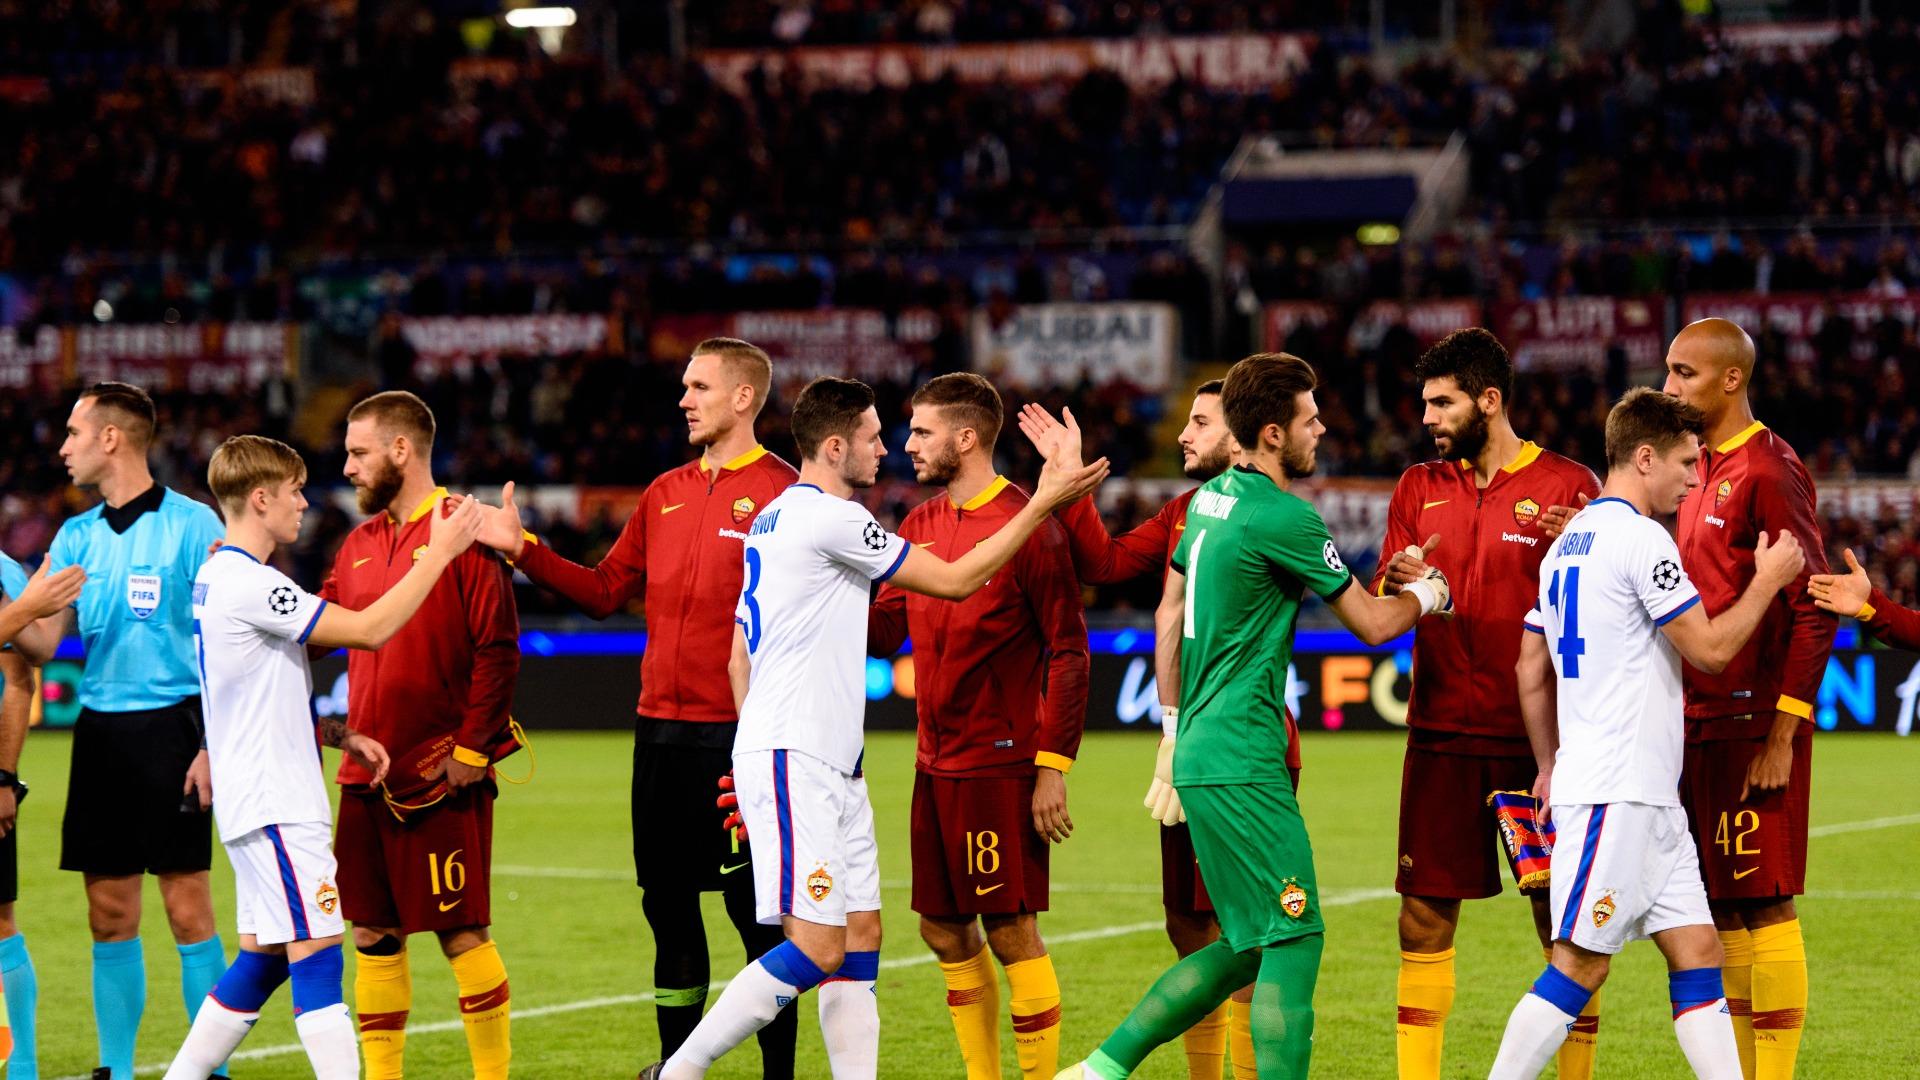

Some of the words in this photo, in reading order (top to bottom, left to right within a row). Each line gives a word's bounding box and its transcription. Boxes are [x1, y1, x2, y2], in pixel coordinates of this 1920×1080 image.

[1502, 531, 1538, 547] betway
[131, 590, 155, 600] FIFA
[1548, 566, 1585, 678] 14
[966, 830, 1000, 875] 18
[1715, 810, 1761, 856] 42
[428, 848, 466, 895] 16
